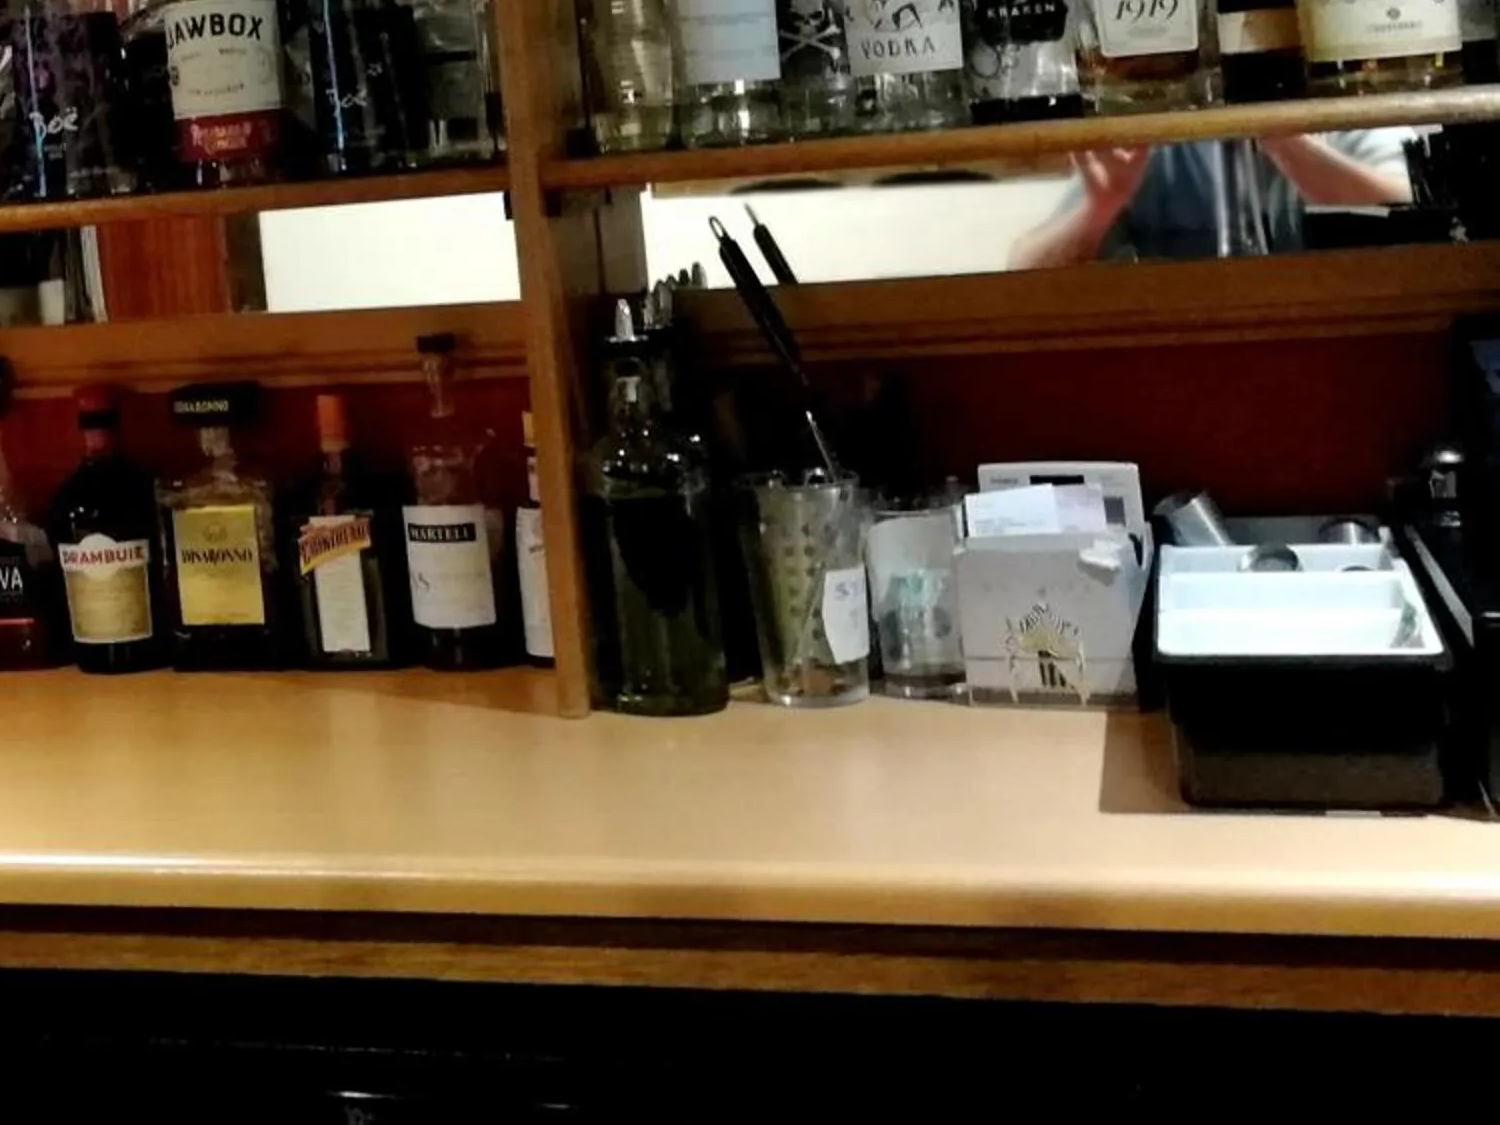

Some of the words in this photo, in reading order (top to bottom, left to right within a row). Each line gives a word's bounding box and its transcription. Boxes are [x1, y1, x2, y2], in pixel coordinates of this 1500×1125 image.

[985, 1, 1057, 20] KRAKEN
[166, 12, 264, 49] JAWBOX
[62, 545, 144, 565] DRAMBUIE
